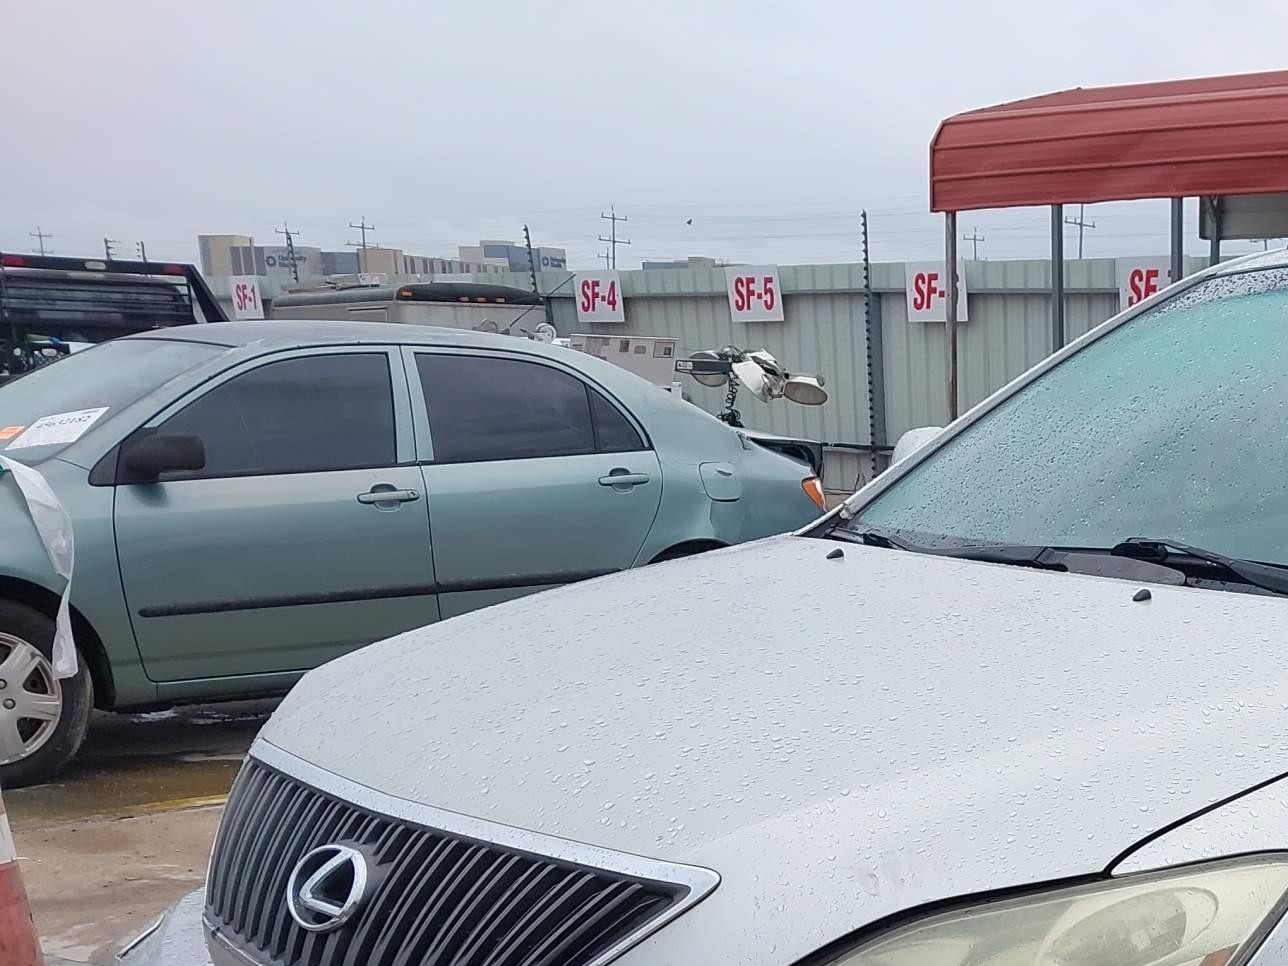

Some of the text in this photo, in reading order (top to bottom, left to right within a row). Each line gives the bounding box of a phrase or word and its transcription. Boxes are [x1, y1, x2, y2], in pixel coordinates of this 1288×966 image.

[236, 284, 257, 311] SF-1
[581, 280, 617, 312] SF-4
[735, 276, 775, 311] SF-5
[914, 273, 959, 310] SF-
